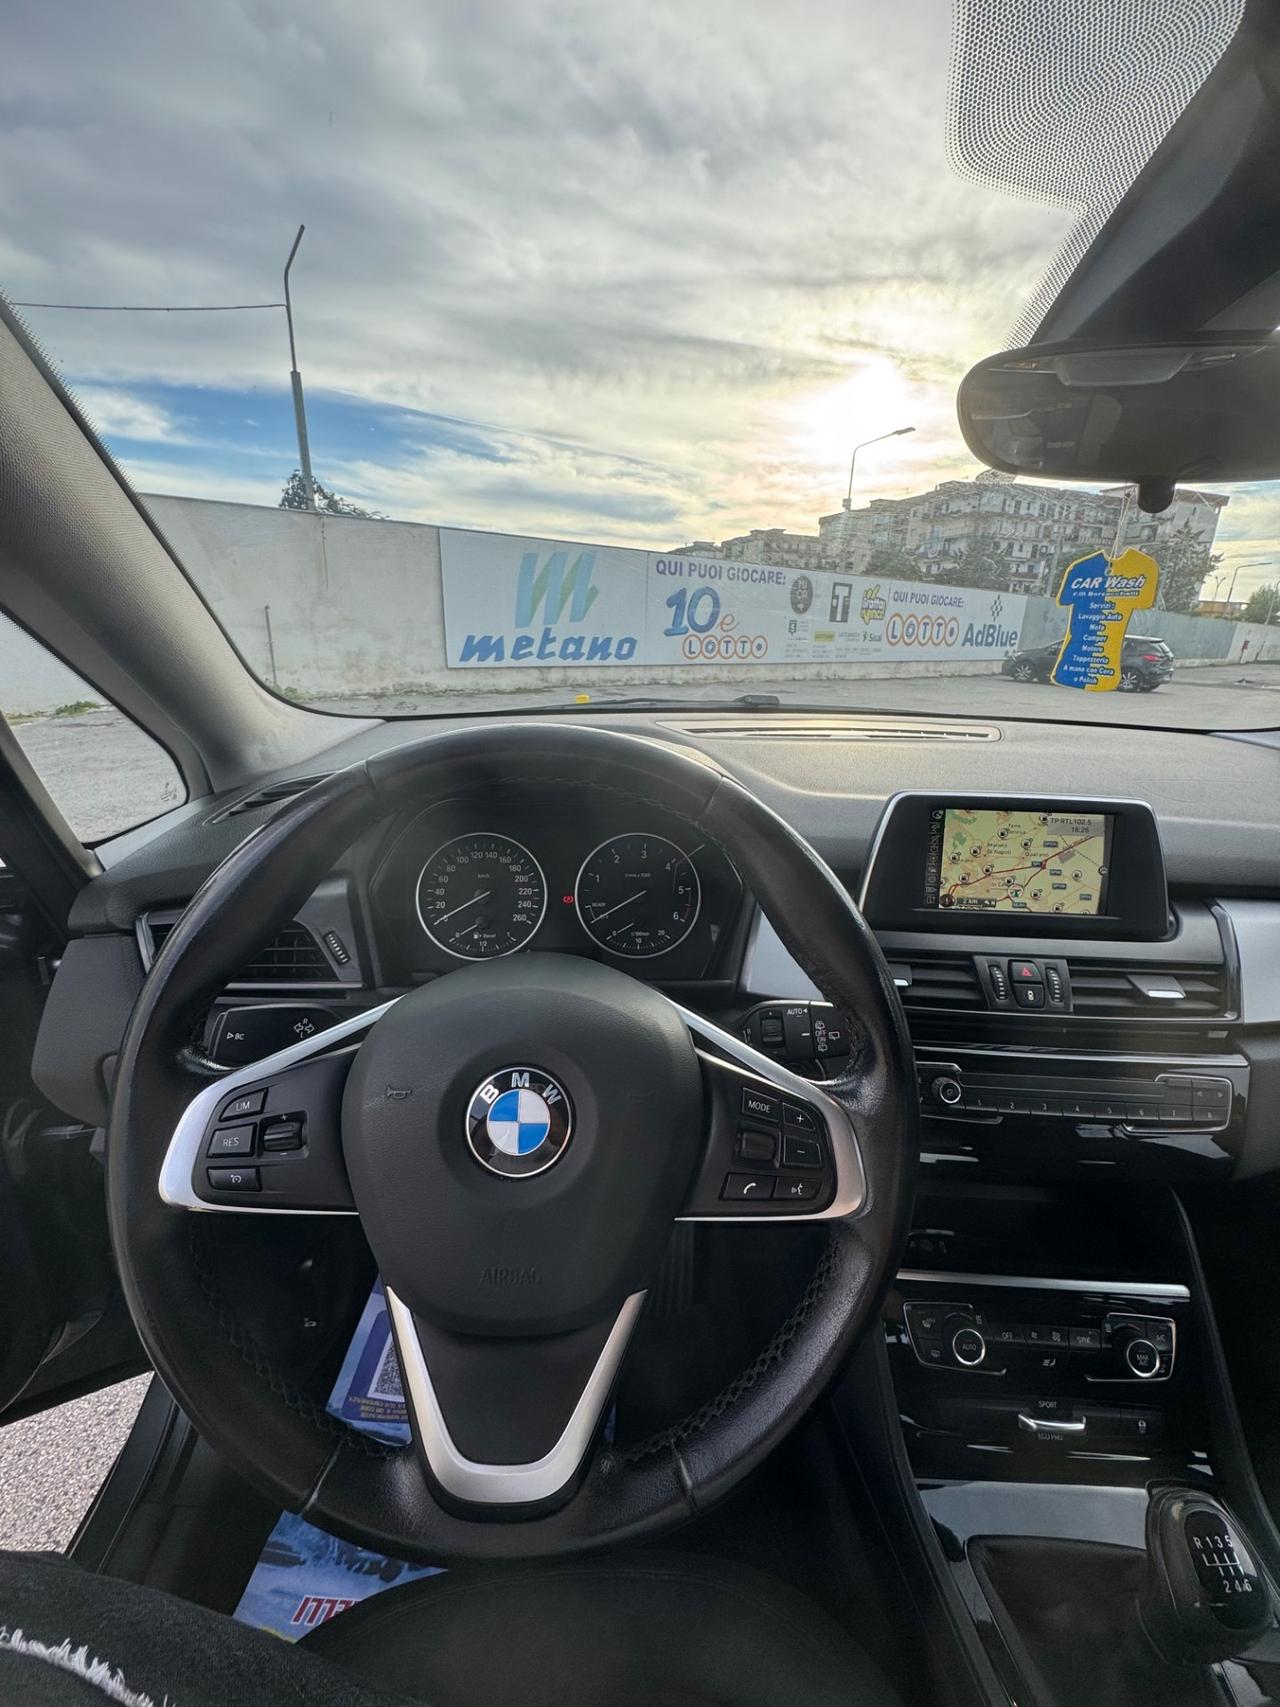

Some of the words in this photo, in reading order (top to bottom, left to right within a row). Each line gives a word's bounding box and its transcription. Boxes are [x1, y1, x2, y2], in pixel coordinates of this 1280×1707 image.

[656, 559, 683, 576] QUI
[688, 562, 722, 580] PUOI
[727, 566, 786, 586] GIOCARE:
[1072, 576, 1103, 589] CAR
[1105, 576, 1146, 588] Wash
[893, 591, 908, 602] QUI
[910, 592, 930, 605] PUOI
[931, 594, 964, 608] GIOCARE:
[664, 586, 720, 637] 10
[716, 614, 740, 632] e
[1078, 613, 1105, 621] Lavaggio
[889, 616, 958, 644] LOTTO
[962, 623, 1018, 647] AdBlue
[459, 627, 638, 662] metano
[685, 636, 766, 658] LOTTO
[614, 855, 620, 864] 2
[641, 851, 647, 859] 3
[665, 863, 670, 871] 4
[678, 886, 684, 894] 5
[480, 1072, 562, 1104] BMW
[236, 1102, 250, 1111] LIM
[748, 1100, 770, 1114] MODE
[223, 1138, 239, 1147] RES
[1193, 1536, 1203, 1549] R
[1206, 1536, 1213, 1548] 1
[1215, 1536, 1223, 1548] 3
[1224, 1535, 1233, 1547] 5
[1224, 1581, 1231, 1593] 2
[1234, 1580, 1242, 1592] 4
[1244, 1579, 1252, 1592] 6
